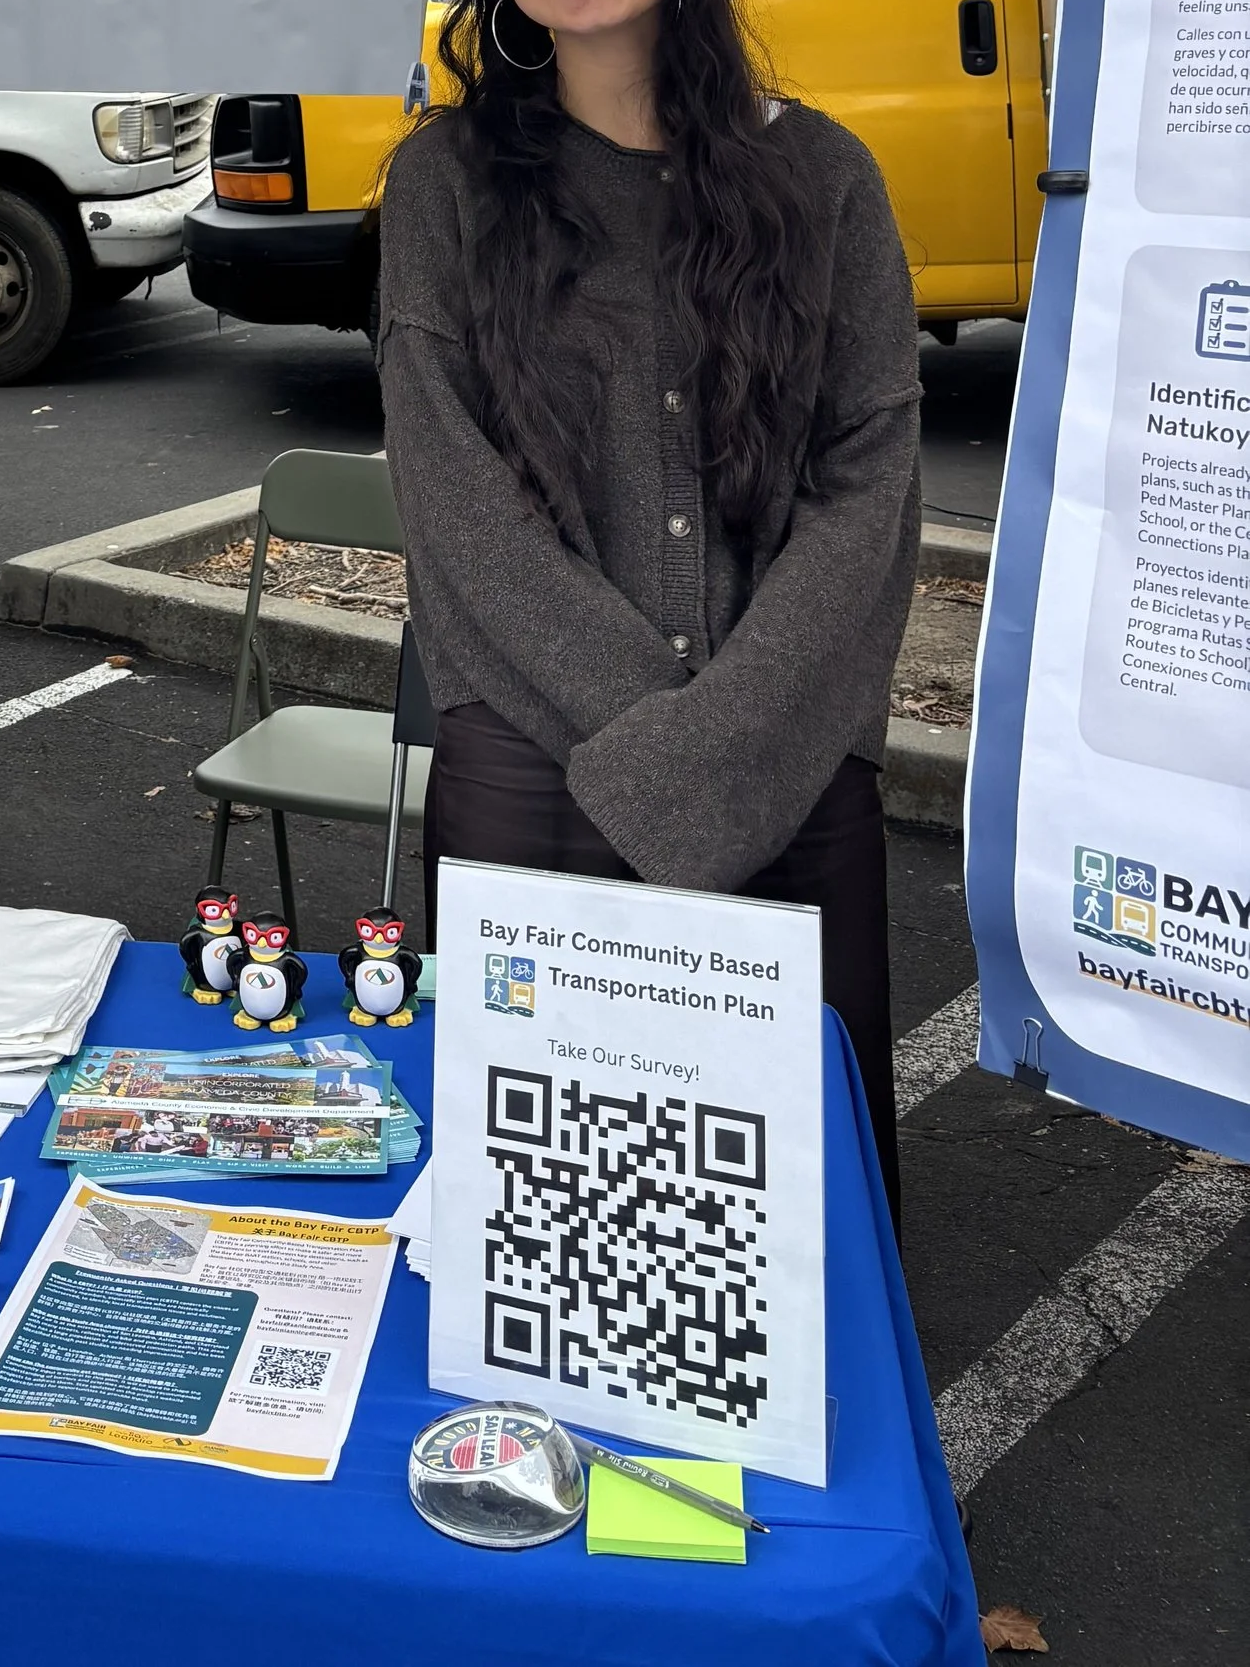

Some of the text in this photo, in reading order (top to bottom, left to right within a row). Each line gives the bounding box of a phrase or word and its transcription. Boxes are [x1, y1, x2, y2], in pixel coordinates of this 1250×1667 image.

[1178, 0, 1222, 15] feeling
[1176, 28, 1241, 41] Calles con
[1174, 49, 1227, 62] graves y
[1172, 64, 1237, 79] velocidad,
[1170, 82, 1186, 95] de
[1189, 86, 1213, 98] que
[1168, 101, 1222, 114] han sido
[1166, 120, 1232, 134] percibirse
[1142, 452, 1198, 472] Projects
[1141, 473, 1233, 498] plans, such as
[1141, 491, 1166, 506] Ped
[1169, 495, 1219, 515] Master
[1139, 510, 1232, 537] School, or the
[1138, 529, 1224, 556] Connections
[1136, 557, 1204, 581] Proyectos
[1133, 577, 1250, 610] planes relevante
[1130, 596, 1232, 629] de Bicicletas y
[1127, 617, 1243, 650] programa Rutas
[1125, 634, 1176, 656] Routes
[1180, 646, 1196, 660] to
[1122, 653, 1208, 683] Conexiones
[1120, 672, 1178, 697] Central.
[480, 919, 780, 981] Bay Fair Community Based
[1160, 920, 1250, 958] COMMU
[549, 966, 775, 1021] Transportation Plan
[1078, 951, 1250, 1028] bayfaircbt
[548, 1038, 700, 1083] Take Our Survey!
[229, 1215, 267, 1225] About
[295, 1220, 317, 1231] Bay
[321, 1223, 345, 1233] Fair
